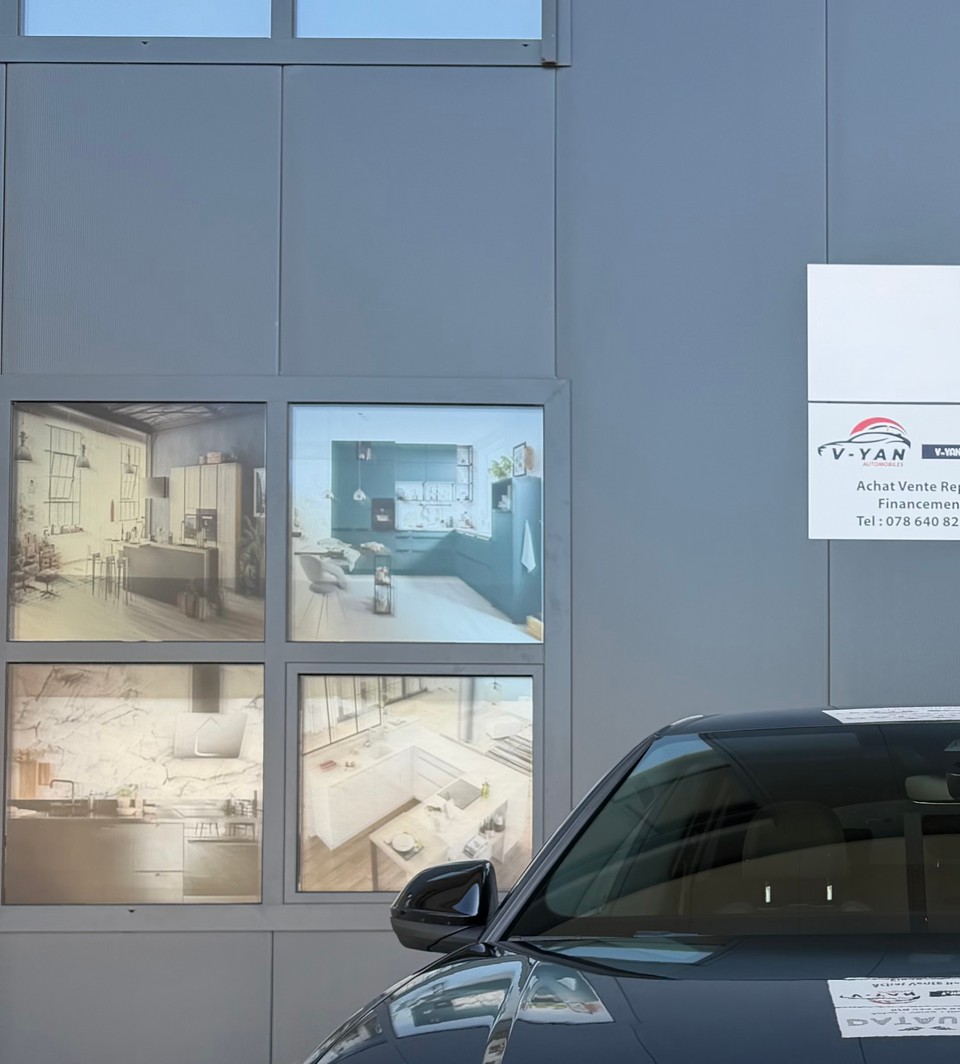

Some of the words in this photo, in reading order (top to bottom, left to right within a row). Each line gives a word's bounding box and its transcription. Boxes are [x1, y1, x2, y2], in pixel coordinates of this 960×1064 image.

[832, 448, 906, 461] V-YAN
[856, 480, 896, 492] Achat
[898, 481, 937, 492] Vente
[856, 515, 876, 527] Tel
[885, 516, 911, 527] 078
[914, 516, 940, 527] 640
[942, 516, 959, 528] 82
